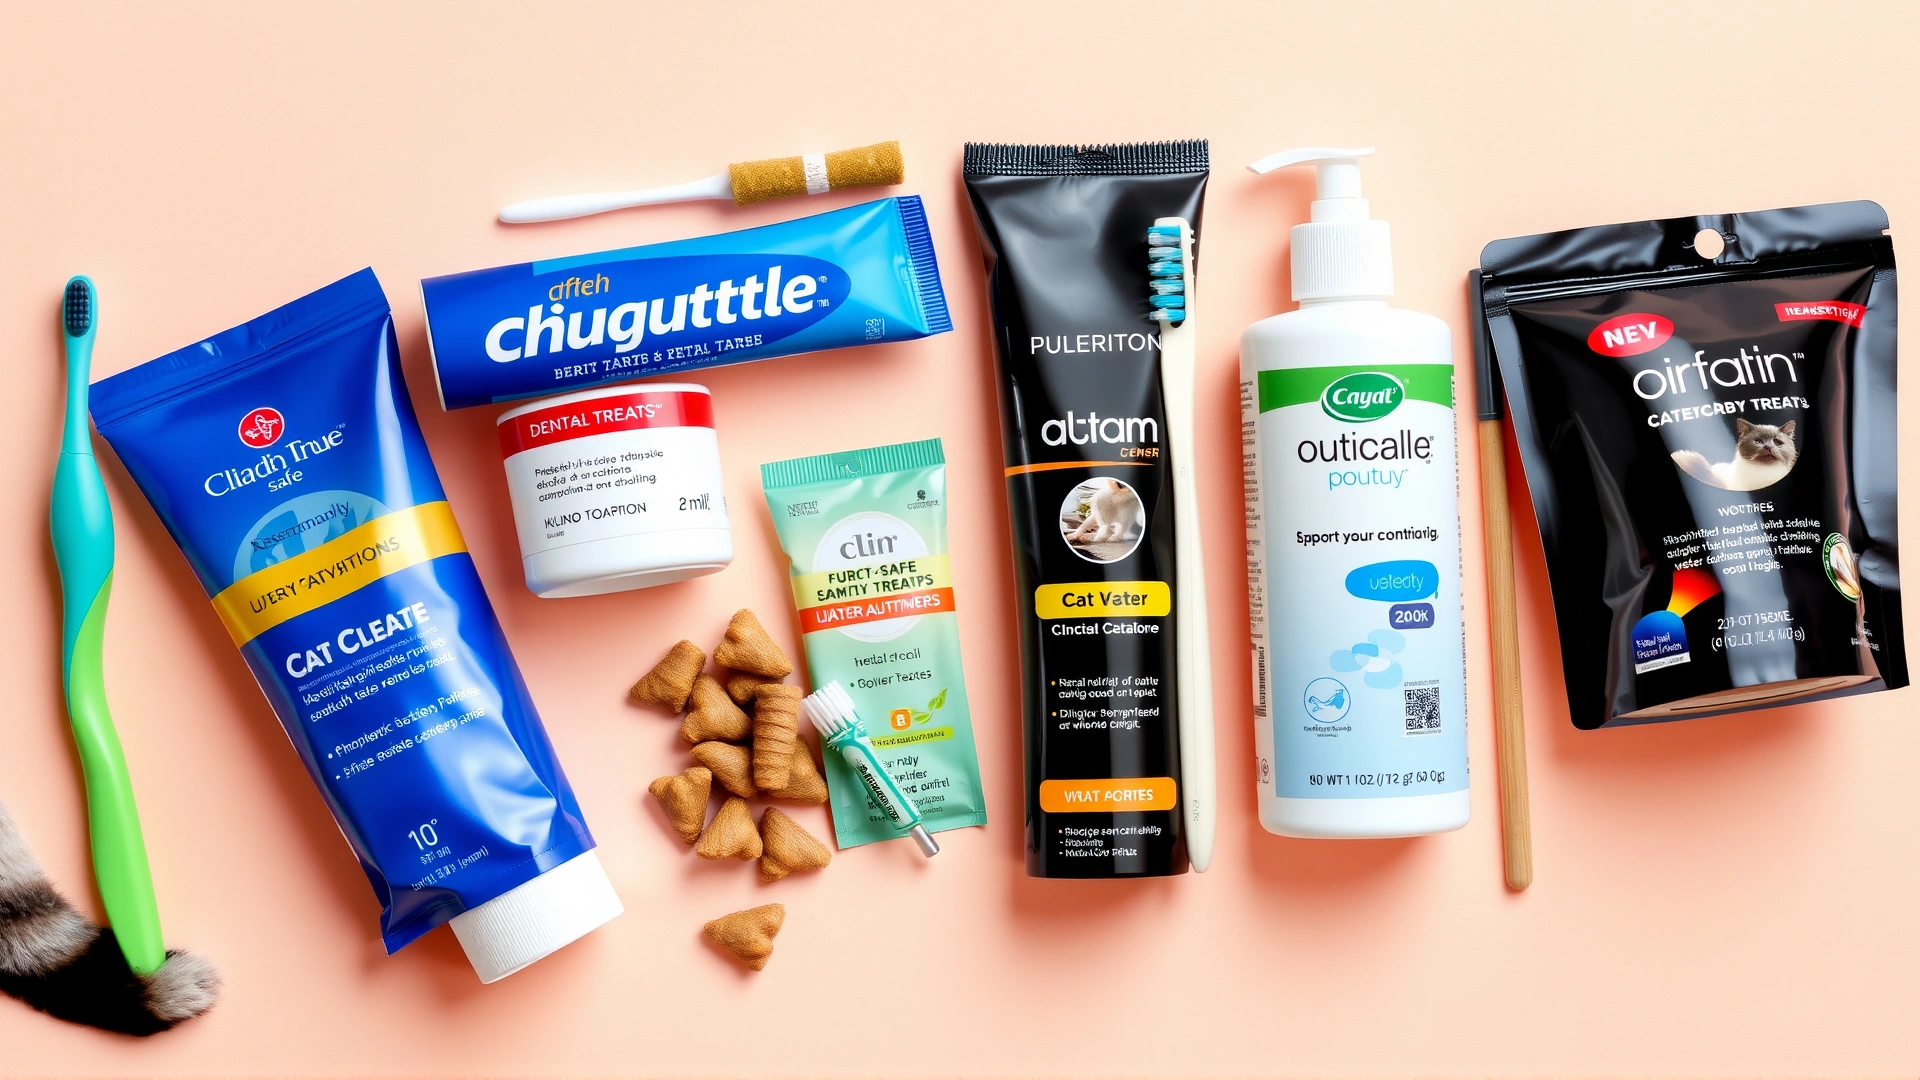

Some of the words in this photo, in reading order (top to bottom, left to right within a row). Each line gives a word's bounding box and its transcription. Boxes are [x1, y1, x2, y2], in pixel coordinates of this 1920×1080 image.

[529, 412, 591, 438] DENTAL
[1061, 591, 1095, 608] Cat
[286, 641, 333, 679] CAT
[337, 601, 431, 655] CLEATE
